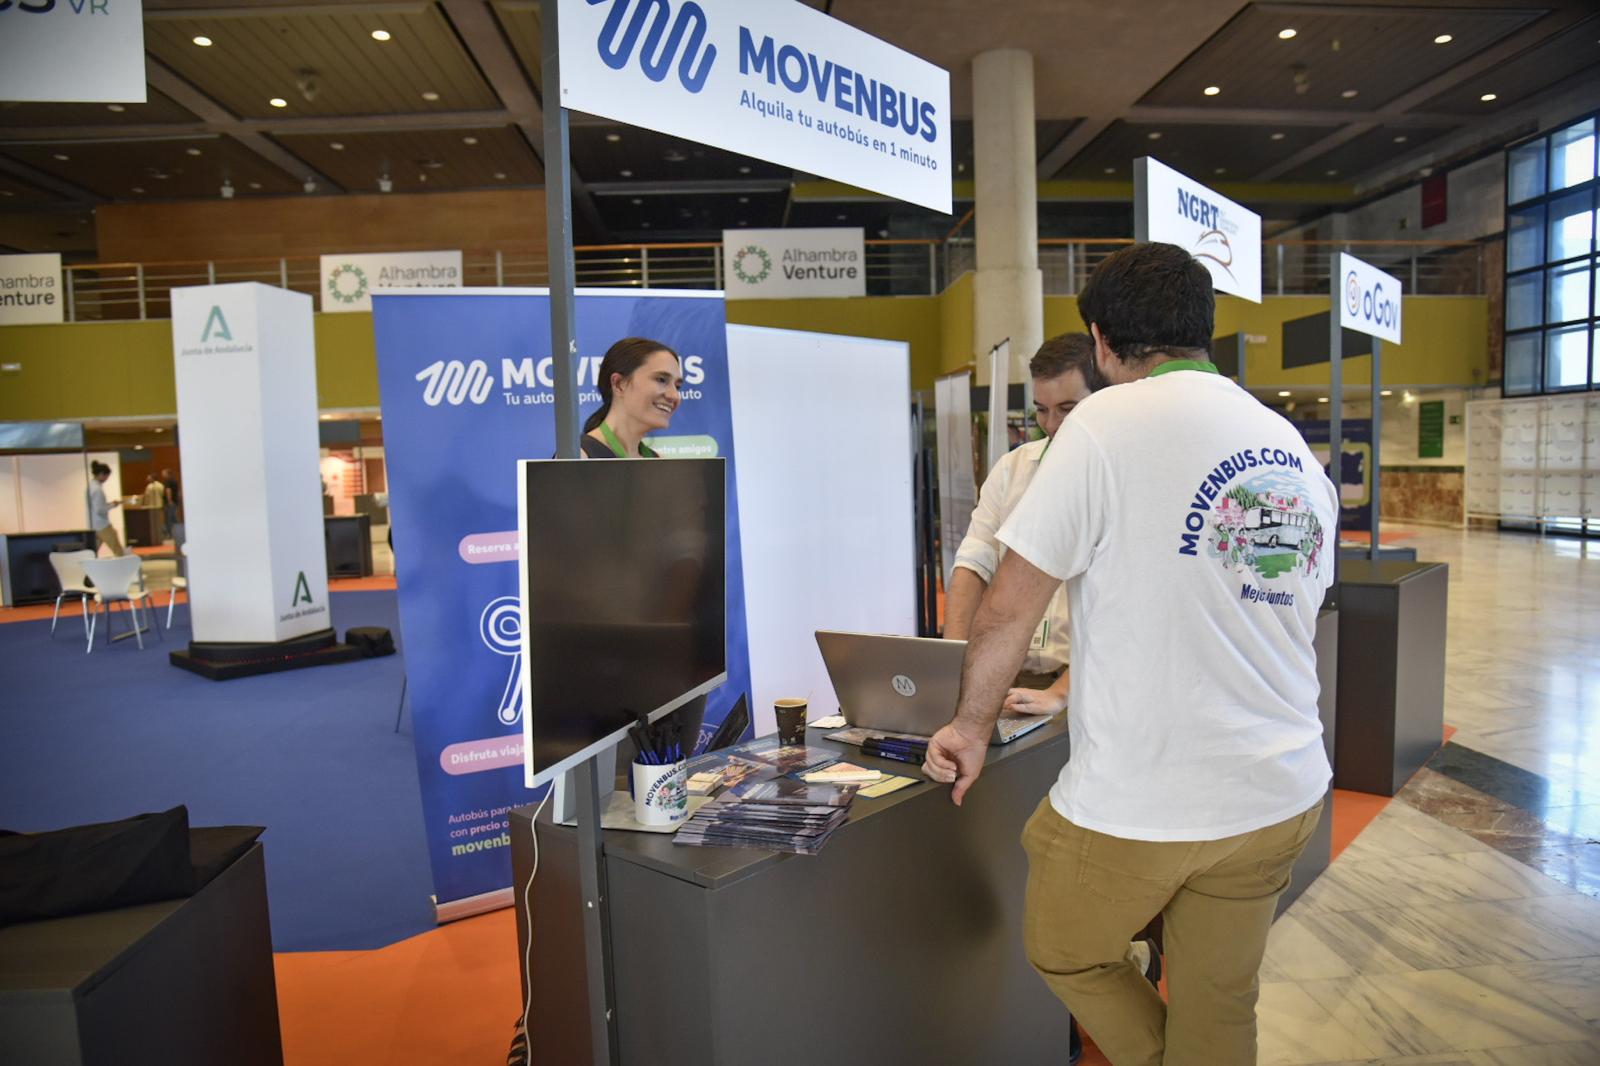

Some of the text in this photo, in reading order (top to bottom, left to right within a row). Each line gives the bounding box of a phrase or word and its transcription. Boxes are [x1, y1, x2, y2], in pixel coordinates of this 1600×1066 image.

[739, 25, 937, 143] MOVENBUS
[740, 89, 938, 171] Alquila tu autobús en 1 minuto
[1178, 187, 1219, 231] NGRT
[783, 248, 857, 262] Alhambra
[379, 264, 457, 280] Alhambra
[783, 264, 857, 280] Venture
[503, 392, 521, 405] Tu
[1179, 448, 1303, 556] MOVENBUS.COM
[467, 543, 512, 555] Reserva
[451, 749, 499, 765] Disfruta
[449, 809, 489, 825] Autobús
[491, 806, 512, 819] para
[450, 828, 468, 838] con
[470, 820, 500, 836] precio
